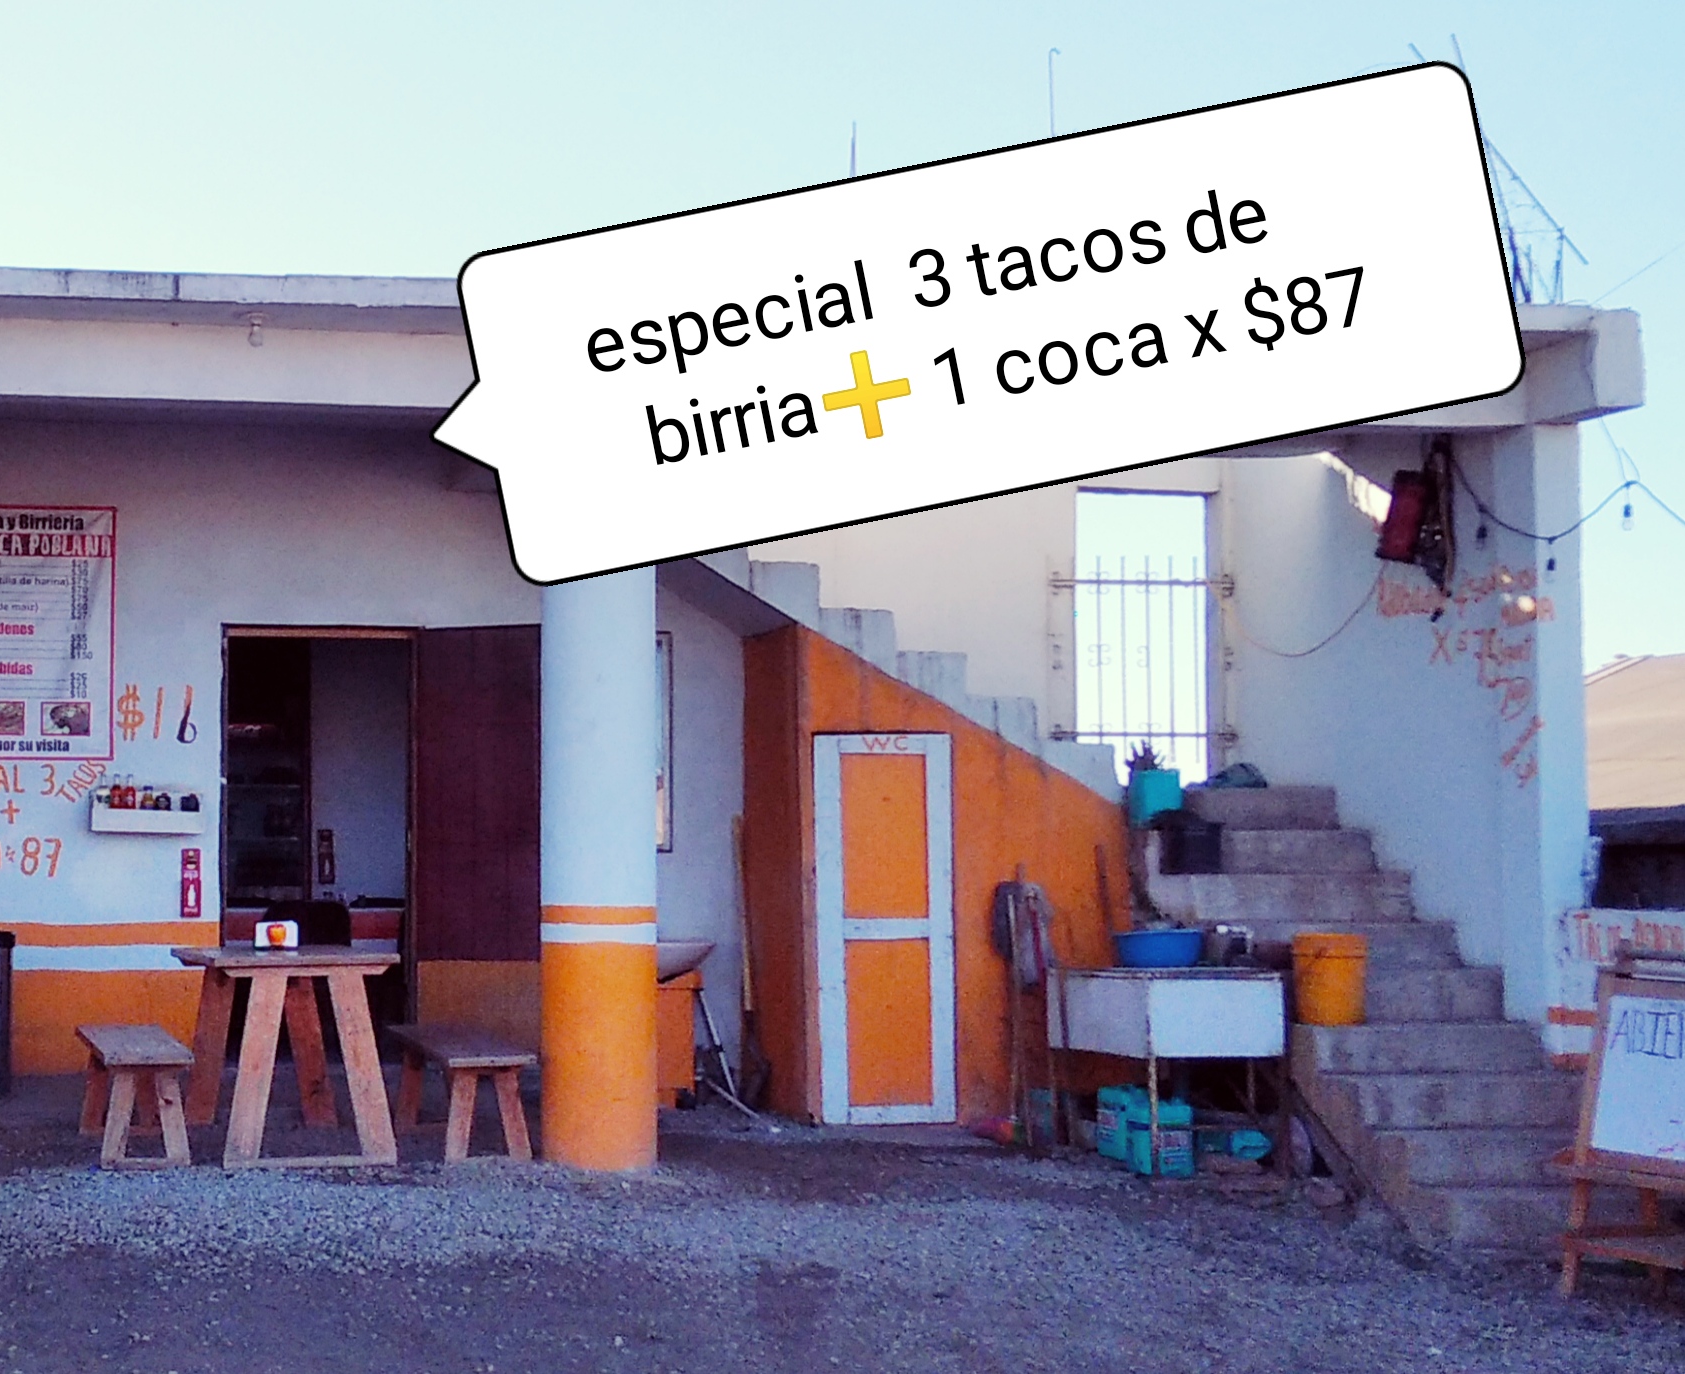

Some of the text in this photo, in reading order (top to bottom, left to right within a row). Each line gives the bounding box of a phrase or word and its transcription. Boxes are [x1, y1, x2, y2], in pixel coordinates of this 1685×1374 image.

[4, 516, 15, 531] y
[29, 534, 111, 556] POBLANA
[20, 577, 32, 585] de
[19, 741, 33, 751] su
[36, 739, 70, 752] visita
[862, 736, 909, 751] WC
[39, 764, 55, 795] 3
